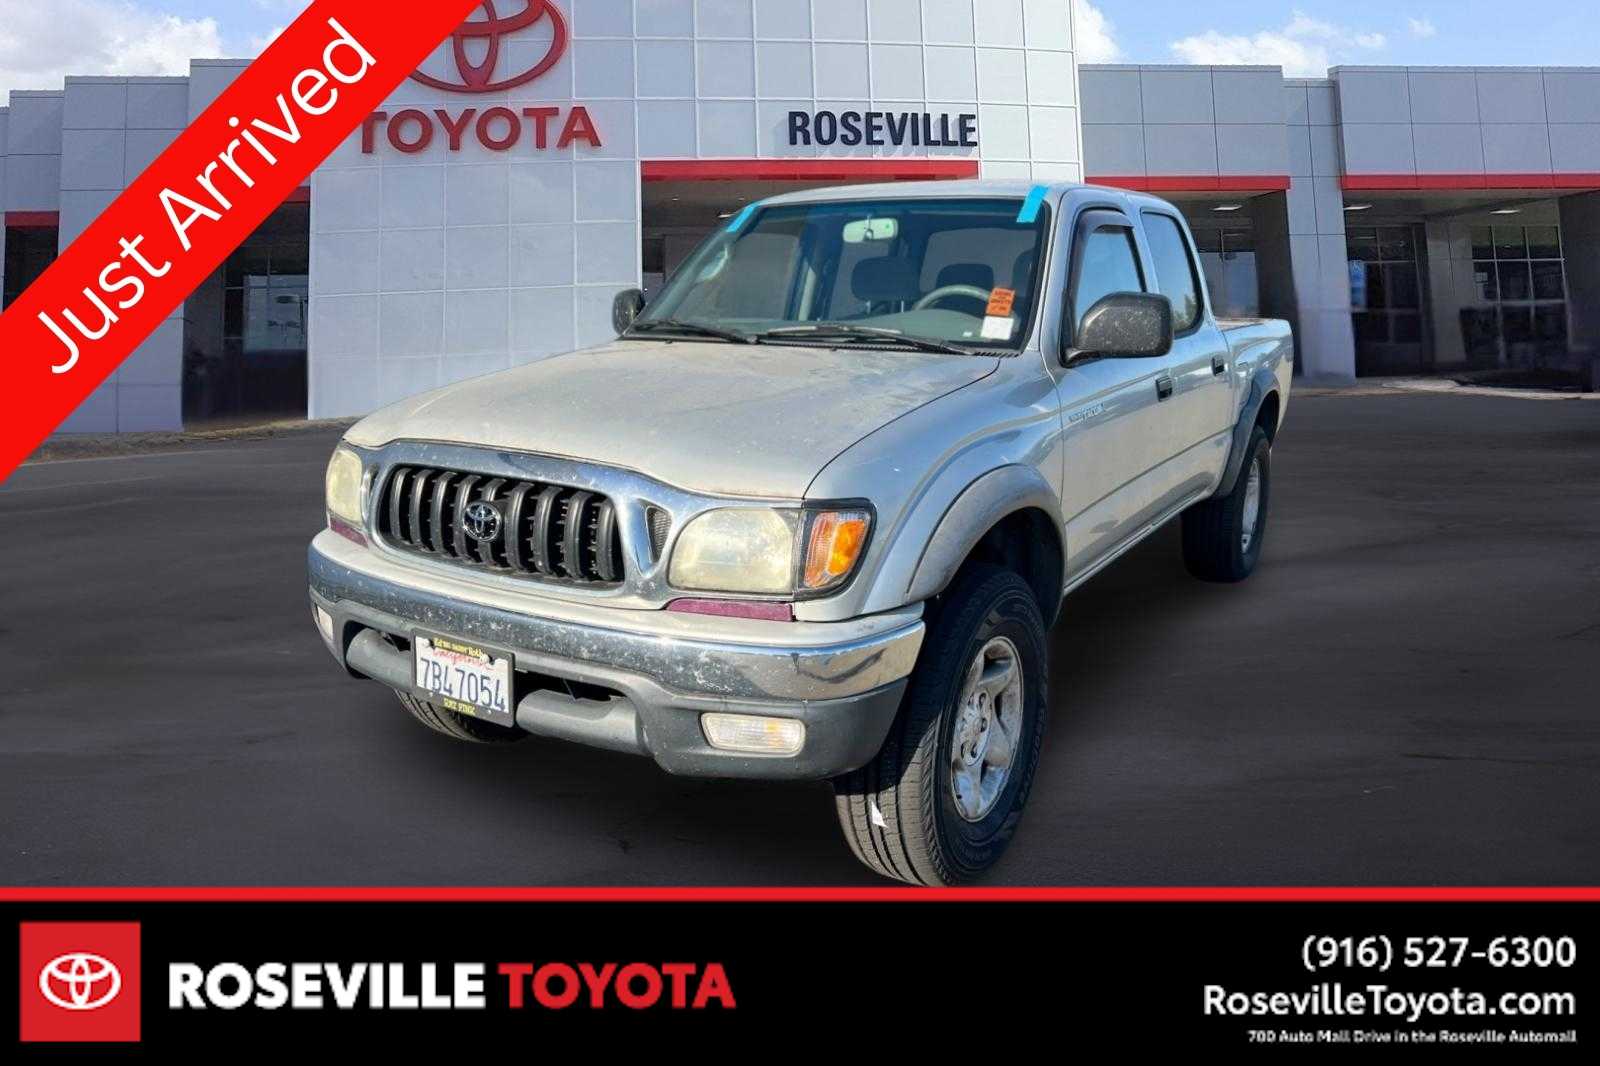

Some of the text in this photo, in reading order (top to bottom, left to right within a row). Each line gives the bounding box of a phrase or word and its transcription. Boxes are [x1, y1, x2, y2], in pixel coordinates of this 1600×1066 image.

[361, 107, 602, 154] TOYOTA
[788, 110, 978, 147] ROSEVILLE
[420, 657, 506, 713] 7B47054
